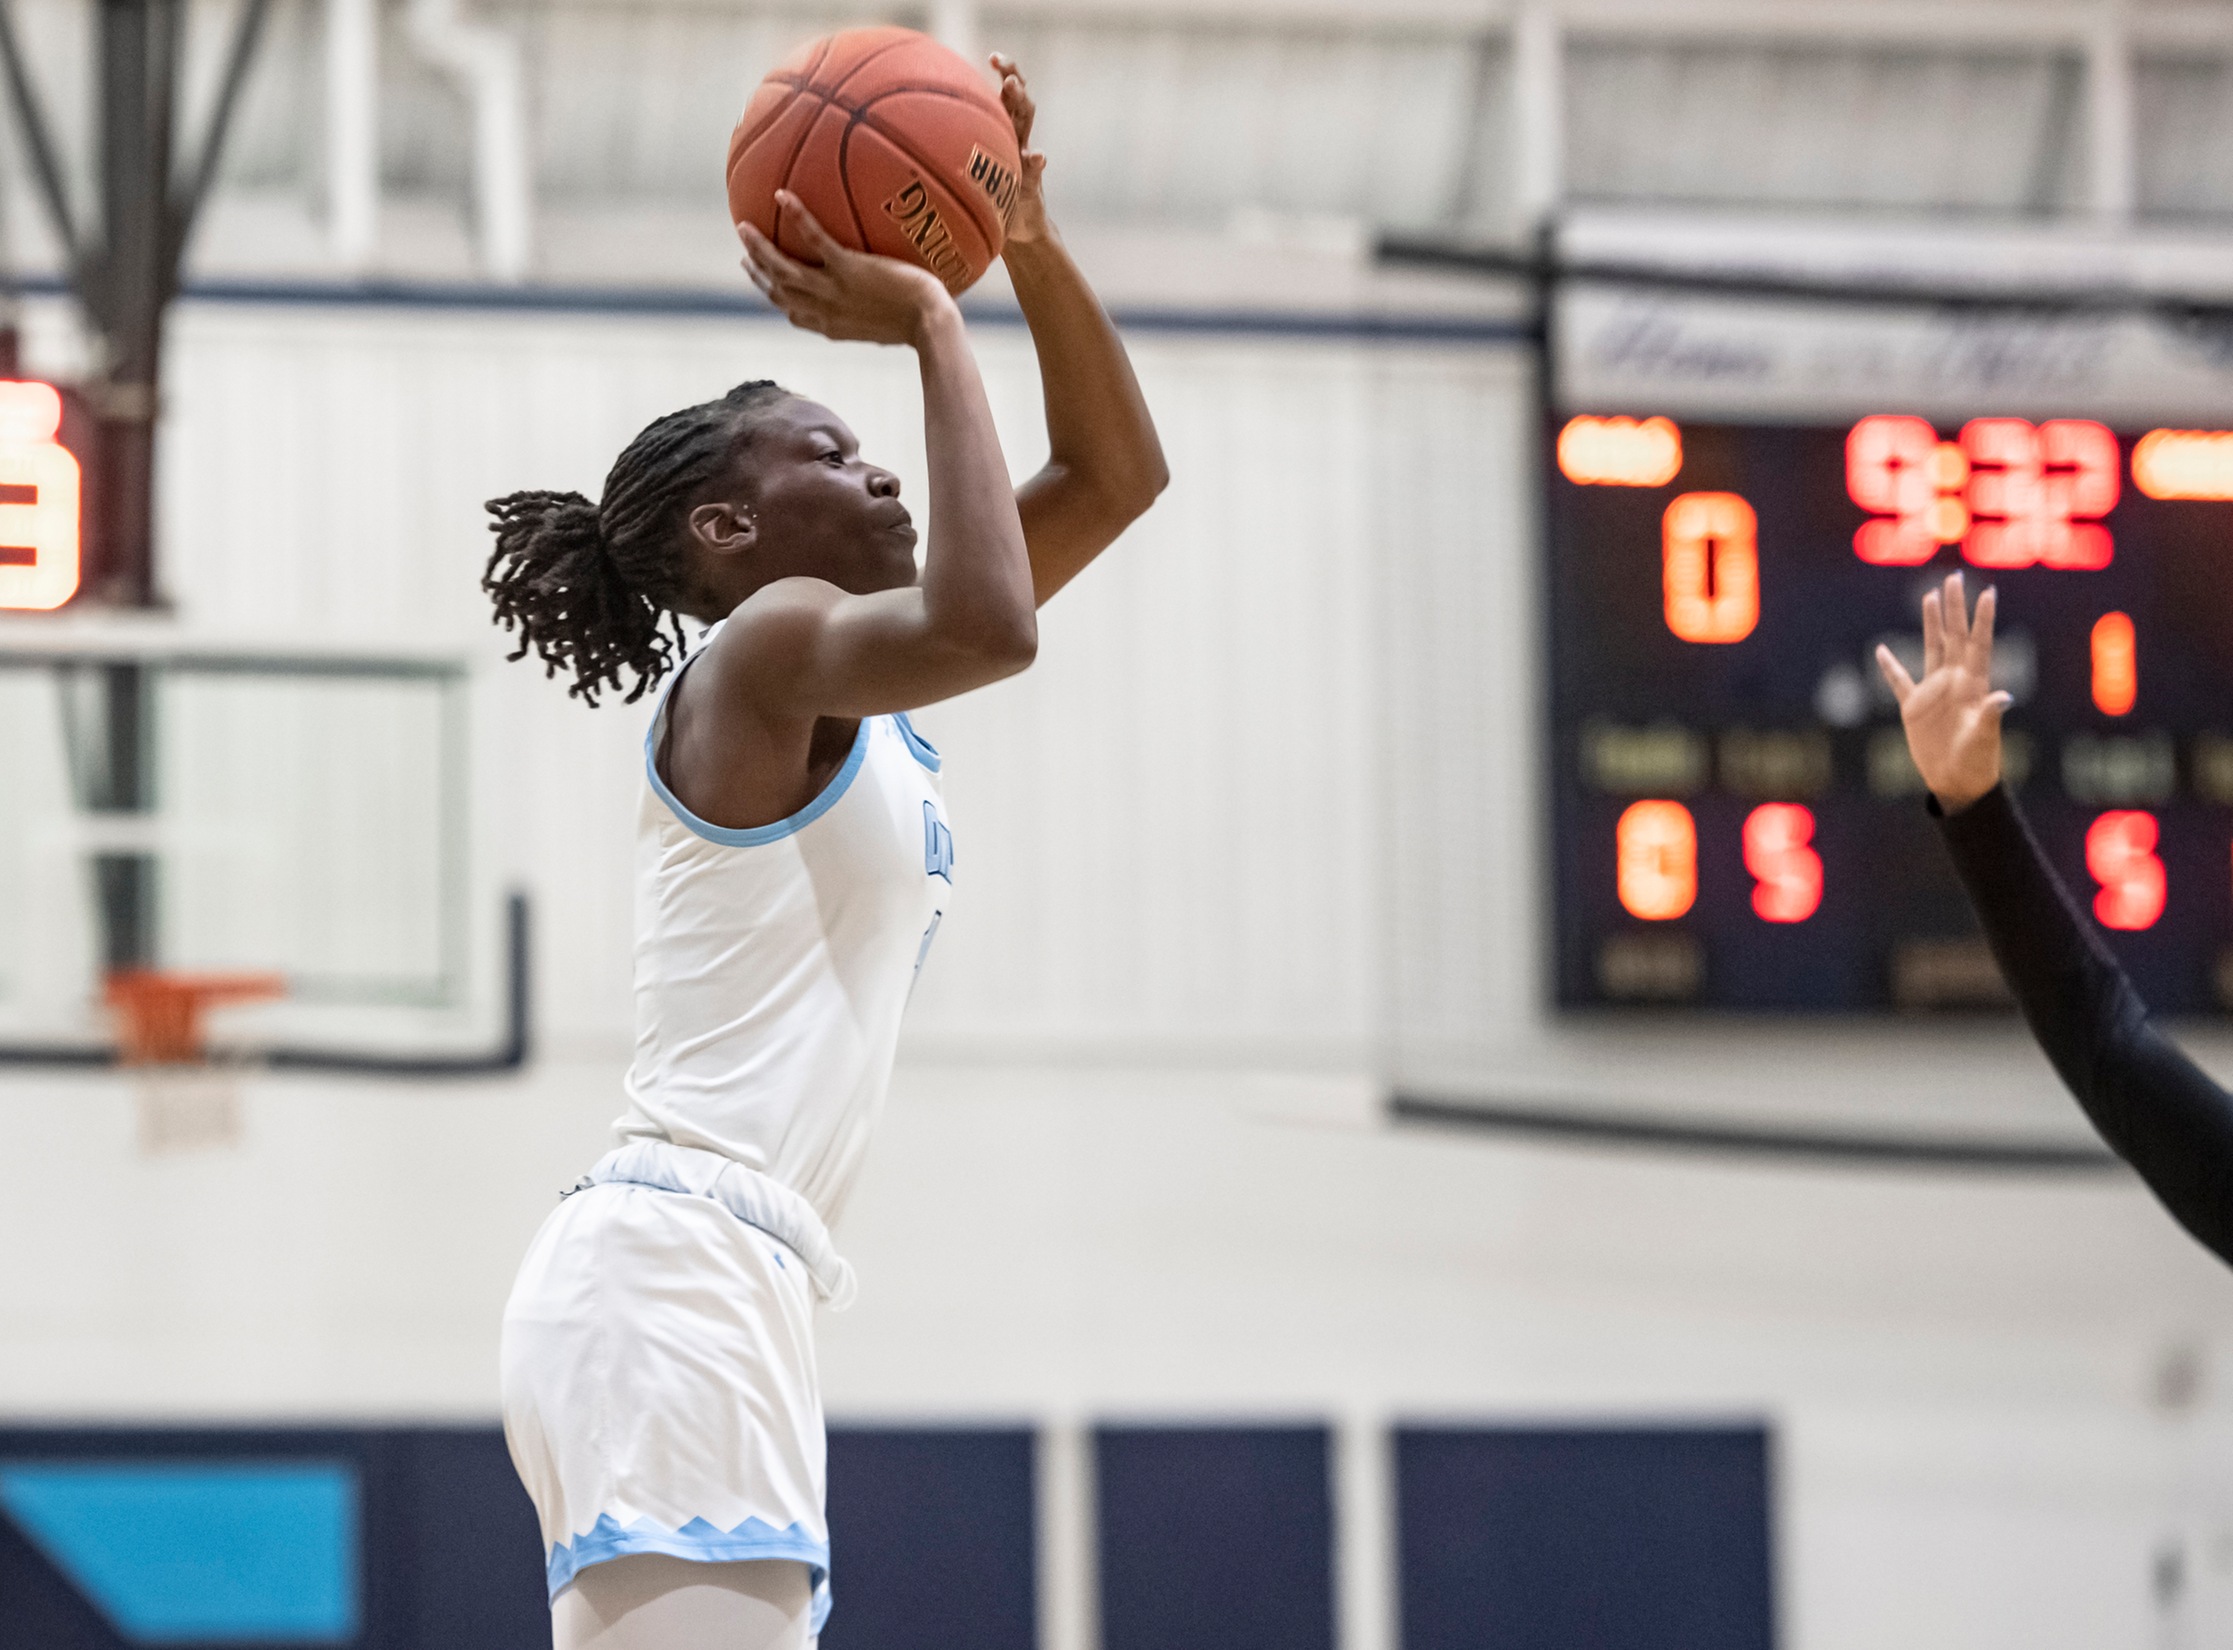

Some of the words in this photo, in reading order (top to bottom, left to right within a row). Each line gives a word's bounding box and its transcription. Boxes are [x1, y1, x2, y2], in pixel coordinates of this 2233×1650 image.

[1663, 491, 1760, 643] 0
[1846, 415, 2121, 571] 9:32
[2091, 611, 2137, 716] 1
